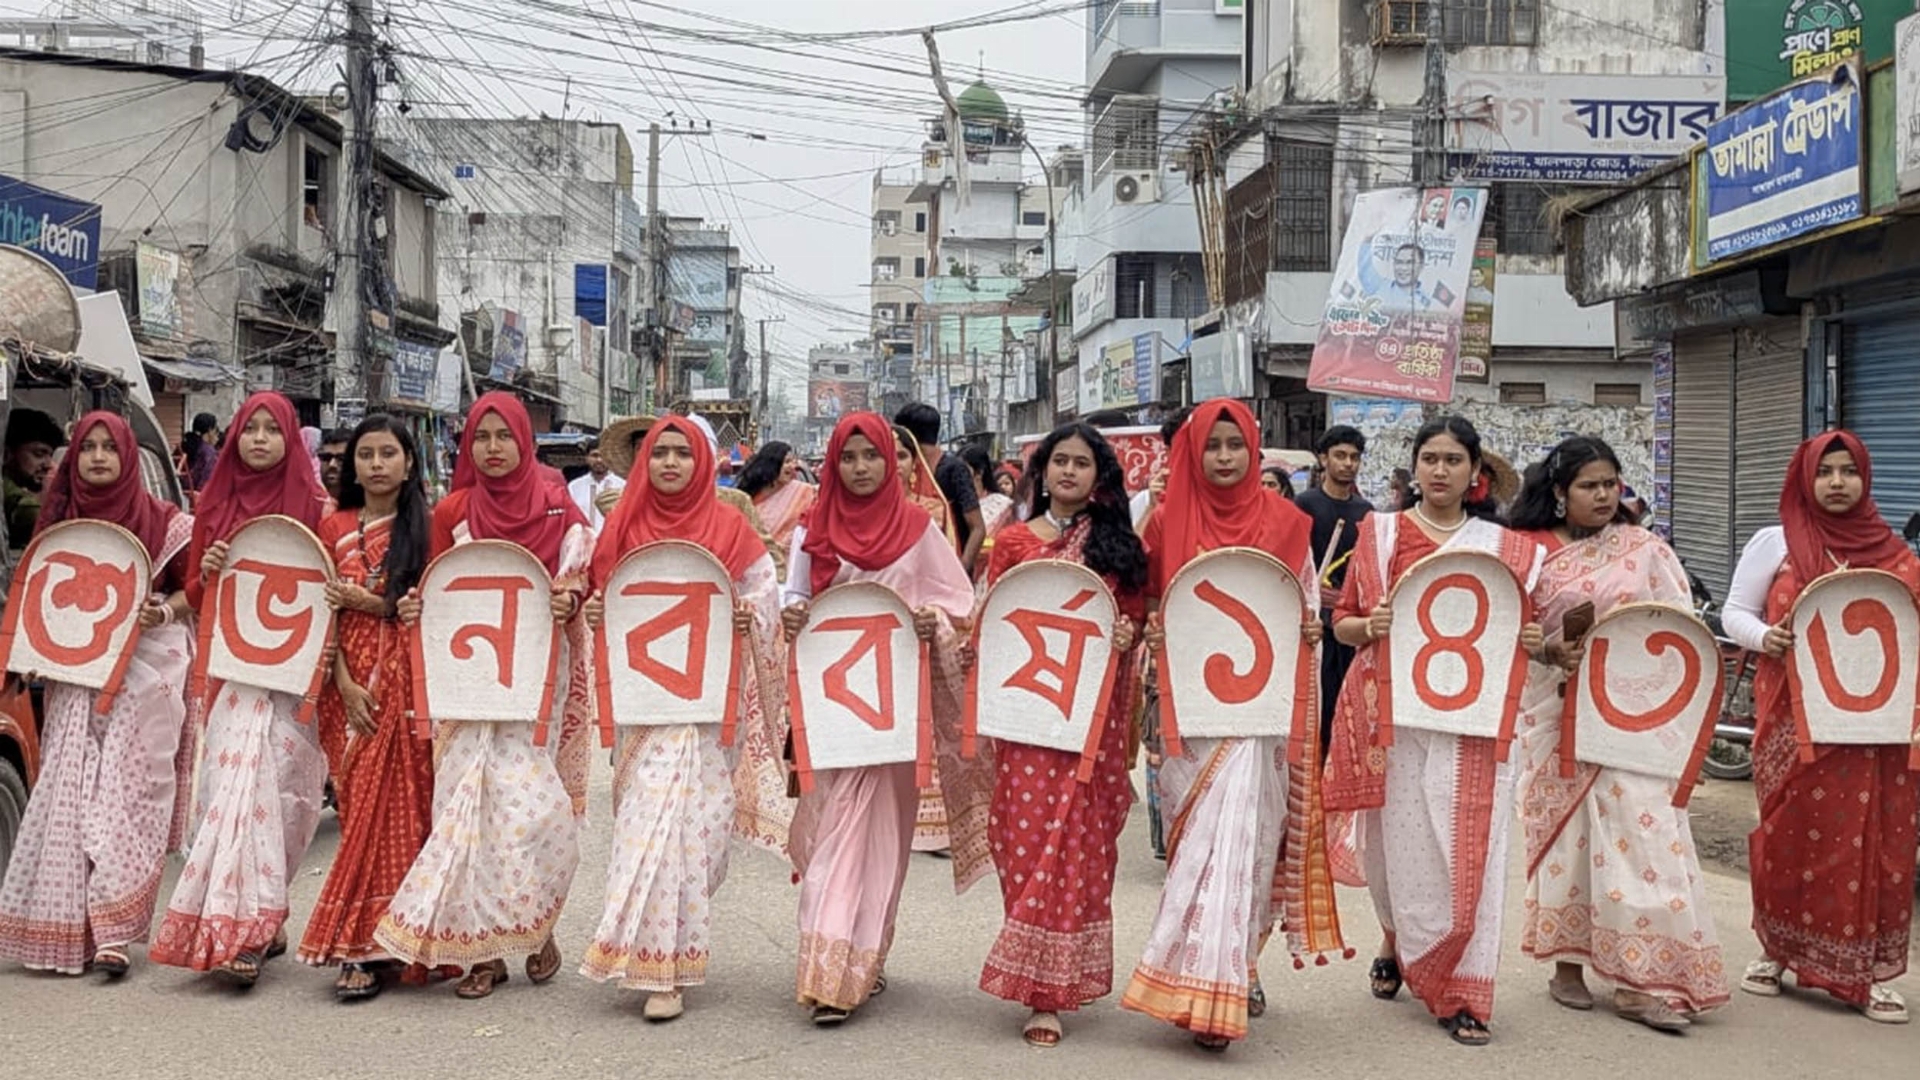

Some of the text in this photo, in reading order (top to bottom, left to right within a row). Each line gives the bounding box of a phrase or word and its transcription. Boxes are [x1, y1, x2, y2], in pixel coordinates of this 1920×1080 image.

[1779, 26, 1861, 60] প্রাণে প্রাণ
[1559, 99, 1720, 140] বাজার
[1709, 116, 1778, 178] তামান্না
[219, 557, 328, 666] ভ
[444, 575, 534, 688] ন
[620, 580, 725, 700] ব
[1001, 588, 1106, 722] র্ষ
[1193, 578, 1275, 704] ১
[1411, 572, 1490, 712] ৪
[1806, 597, 1900, 713] ৩
[811, 612, 905, 731] ব
[1588, 630, 1703, 732] ৩
